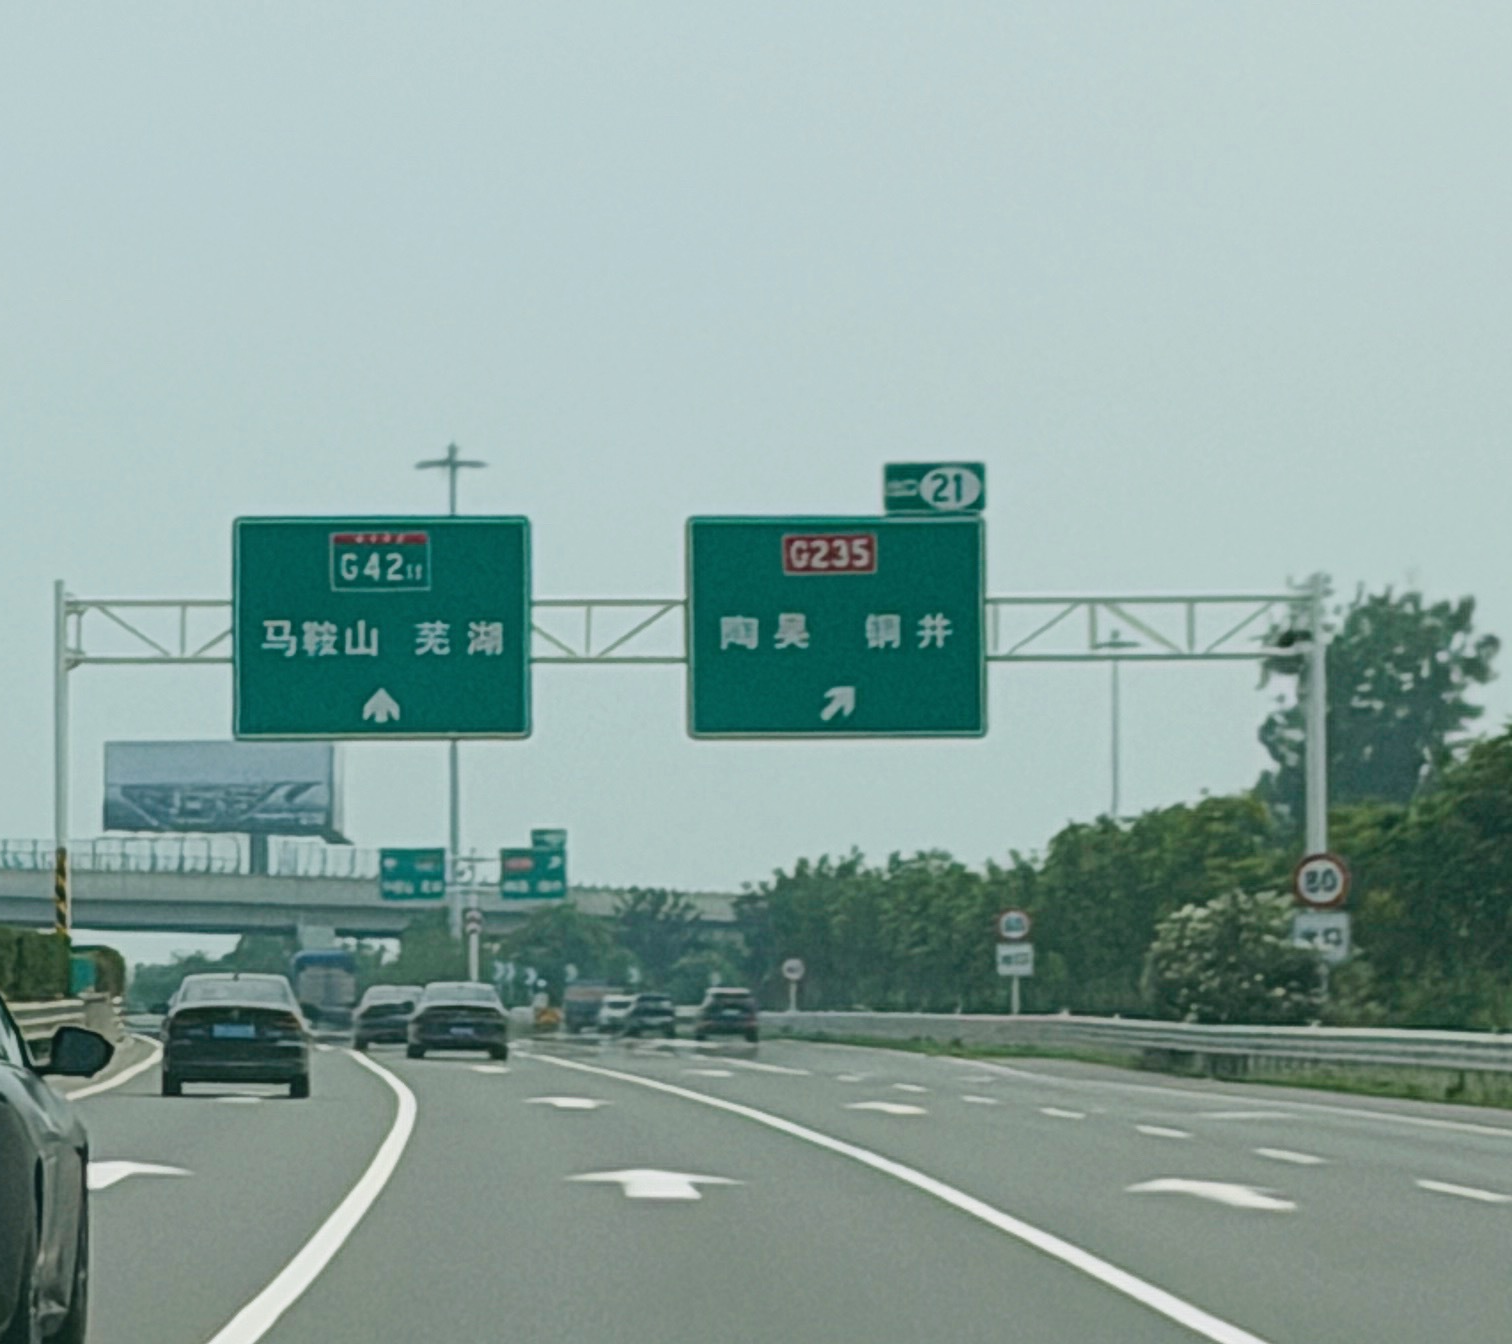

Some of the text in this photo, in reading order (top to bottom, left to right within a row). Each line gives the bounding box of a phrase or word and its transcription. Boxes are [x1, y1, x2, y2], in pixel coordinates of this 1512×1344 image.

[931, 472, 963, 503] 21
[789, 539, 871, 570] G235
[261, 619, 504, 658] 马鞍山 芜湖
